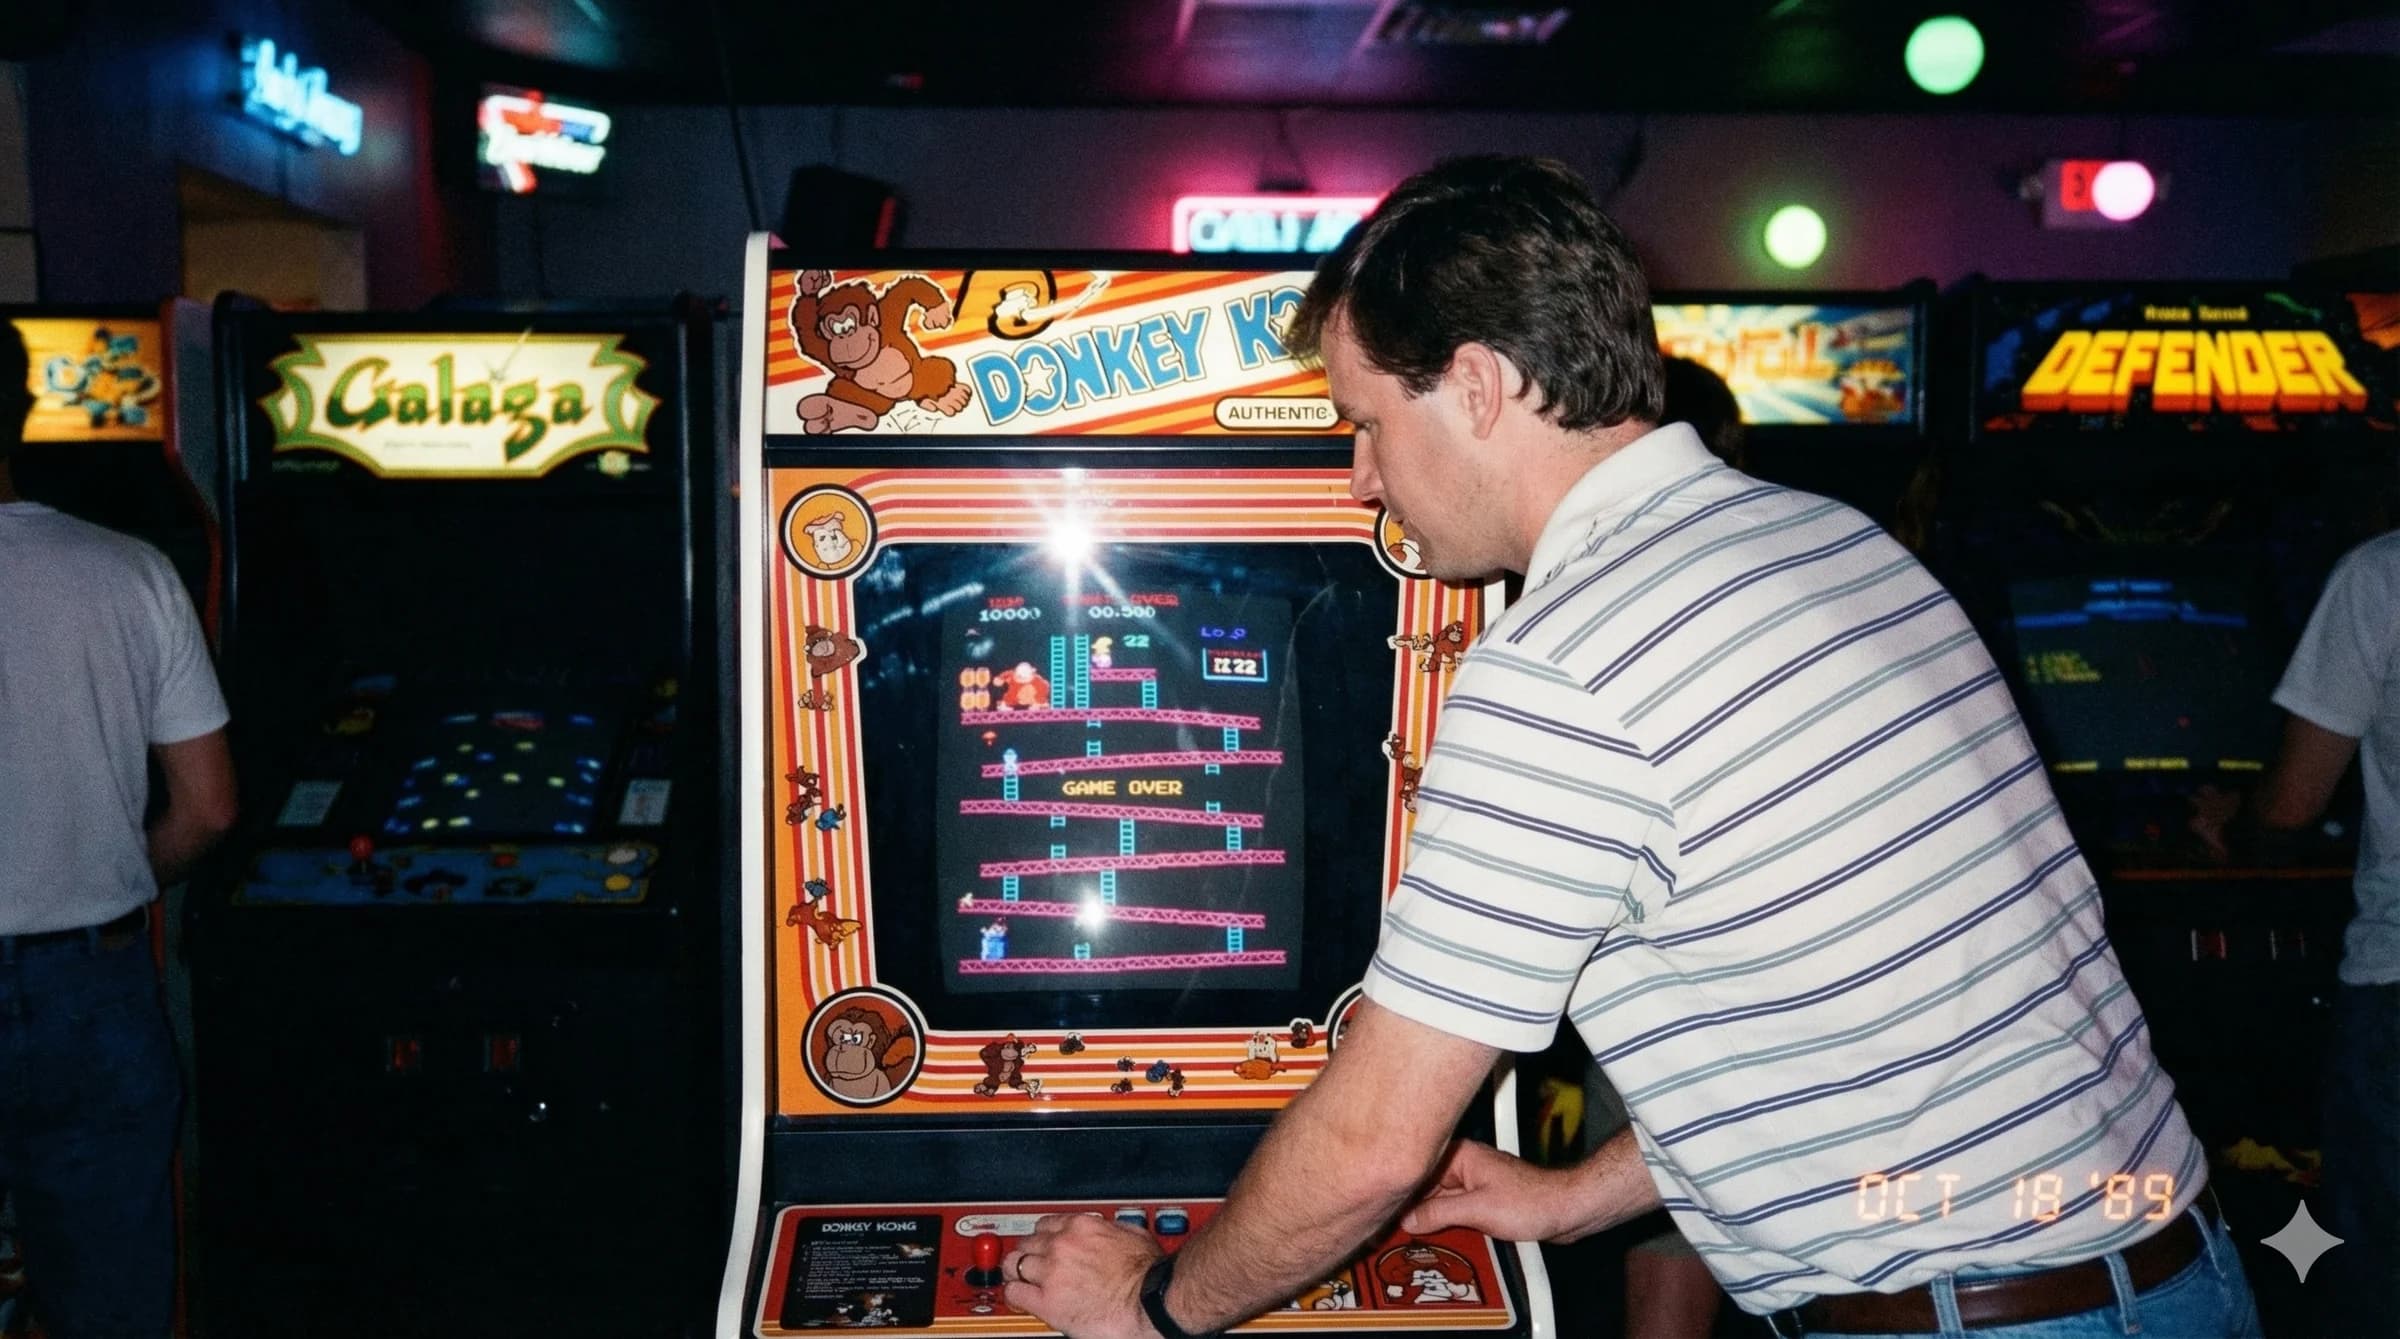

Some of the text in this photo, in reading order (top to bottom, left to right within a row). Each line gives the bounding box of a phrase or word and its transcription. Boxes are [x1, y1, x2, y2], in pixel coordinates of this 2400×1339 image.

[968, 286, 1308, 427] DONKEY KO
[2020, 330, 2369, 411] DEFENDER
[325, 352, 592, 463] Galaga
[1228, 406, 1328, 420] AUTHENTIC
[1123, 634, 1150, 648] 22
[1062, 780, 1183, 796] GAME OVER
